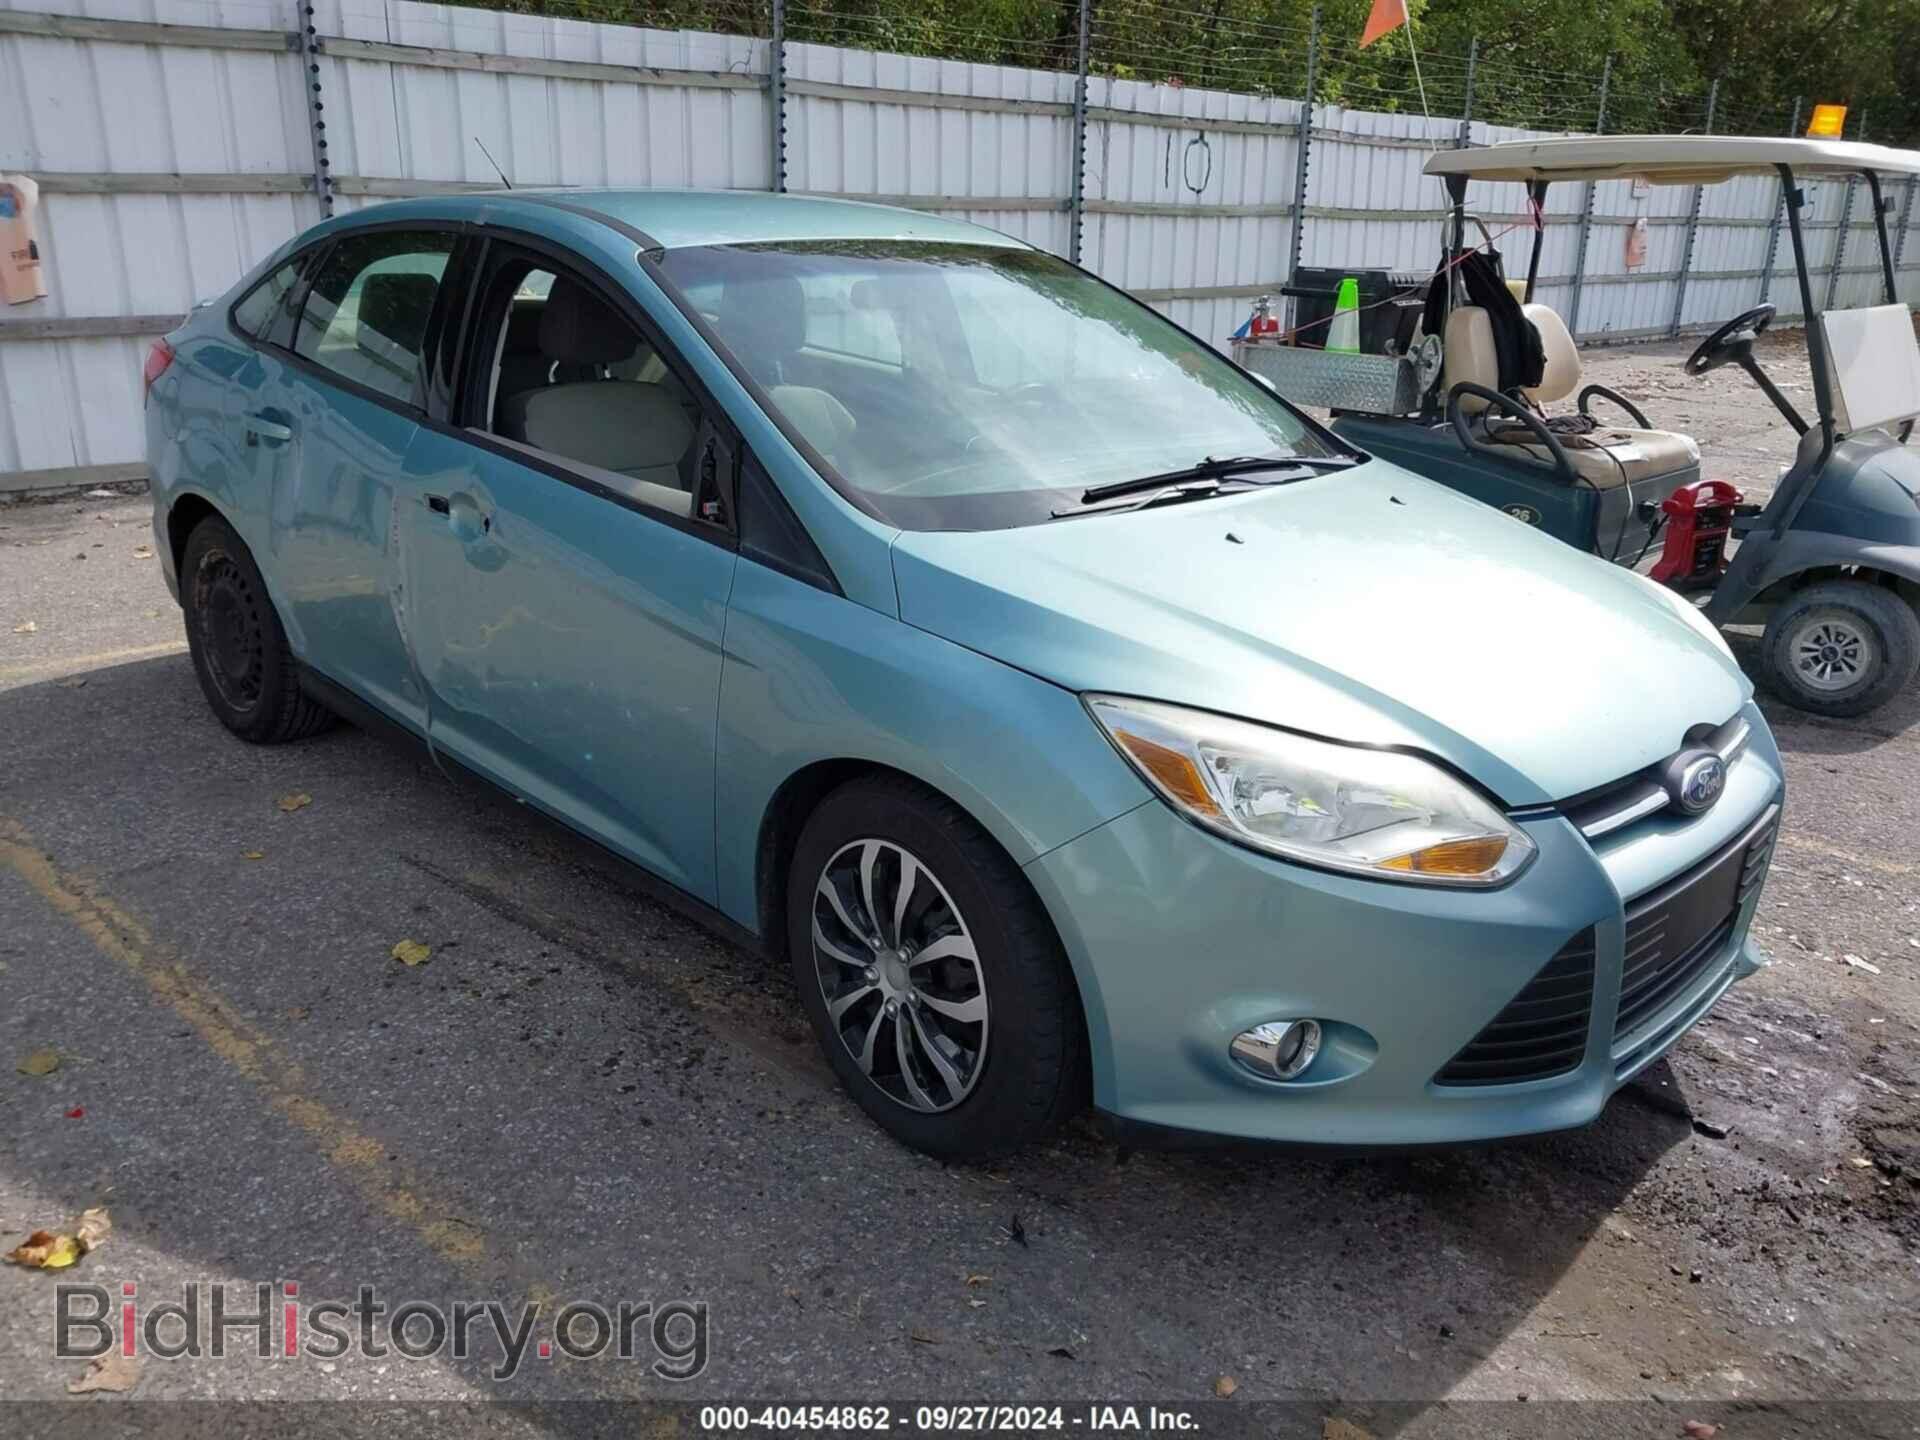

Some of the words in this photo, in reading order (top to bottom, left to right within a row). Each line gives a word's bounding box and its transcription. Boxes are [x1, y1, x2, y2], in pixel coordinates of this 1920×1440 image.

[1165, 130, 1211, 194] 10
[1511, 508, 1531, 523] 26
[1697, 765, 1722, 799] Ford
